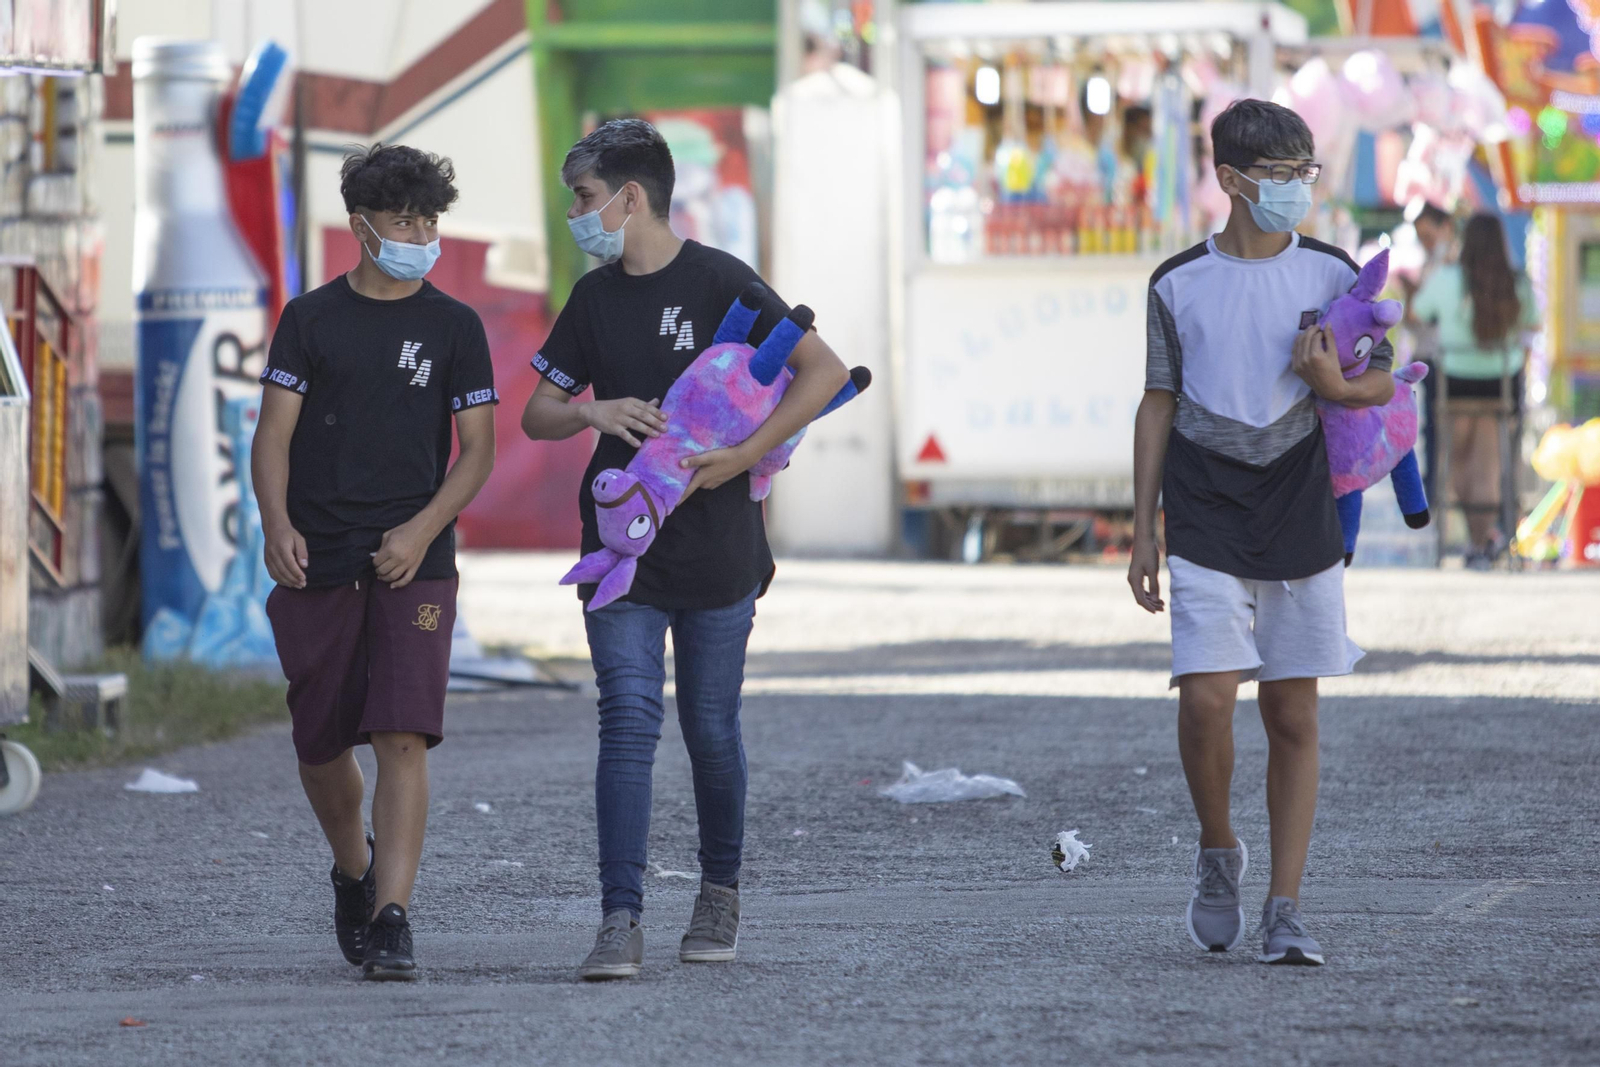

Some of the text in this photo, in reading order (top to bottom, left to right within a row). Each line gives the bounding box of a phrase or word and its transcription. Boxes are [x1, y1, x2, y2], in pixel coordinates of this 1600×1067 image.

[268, 368, 298, 388] KEEP
[547, 367, 576, 389] KEEP
[465, 388, 493, 407] KEEP
